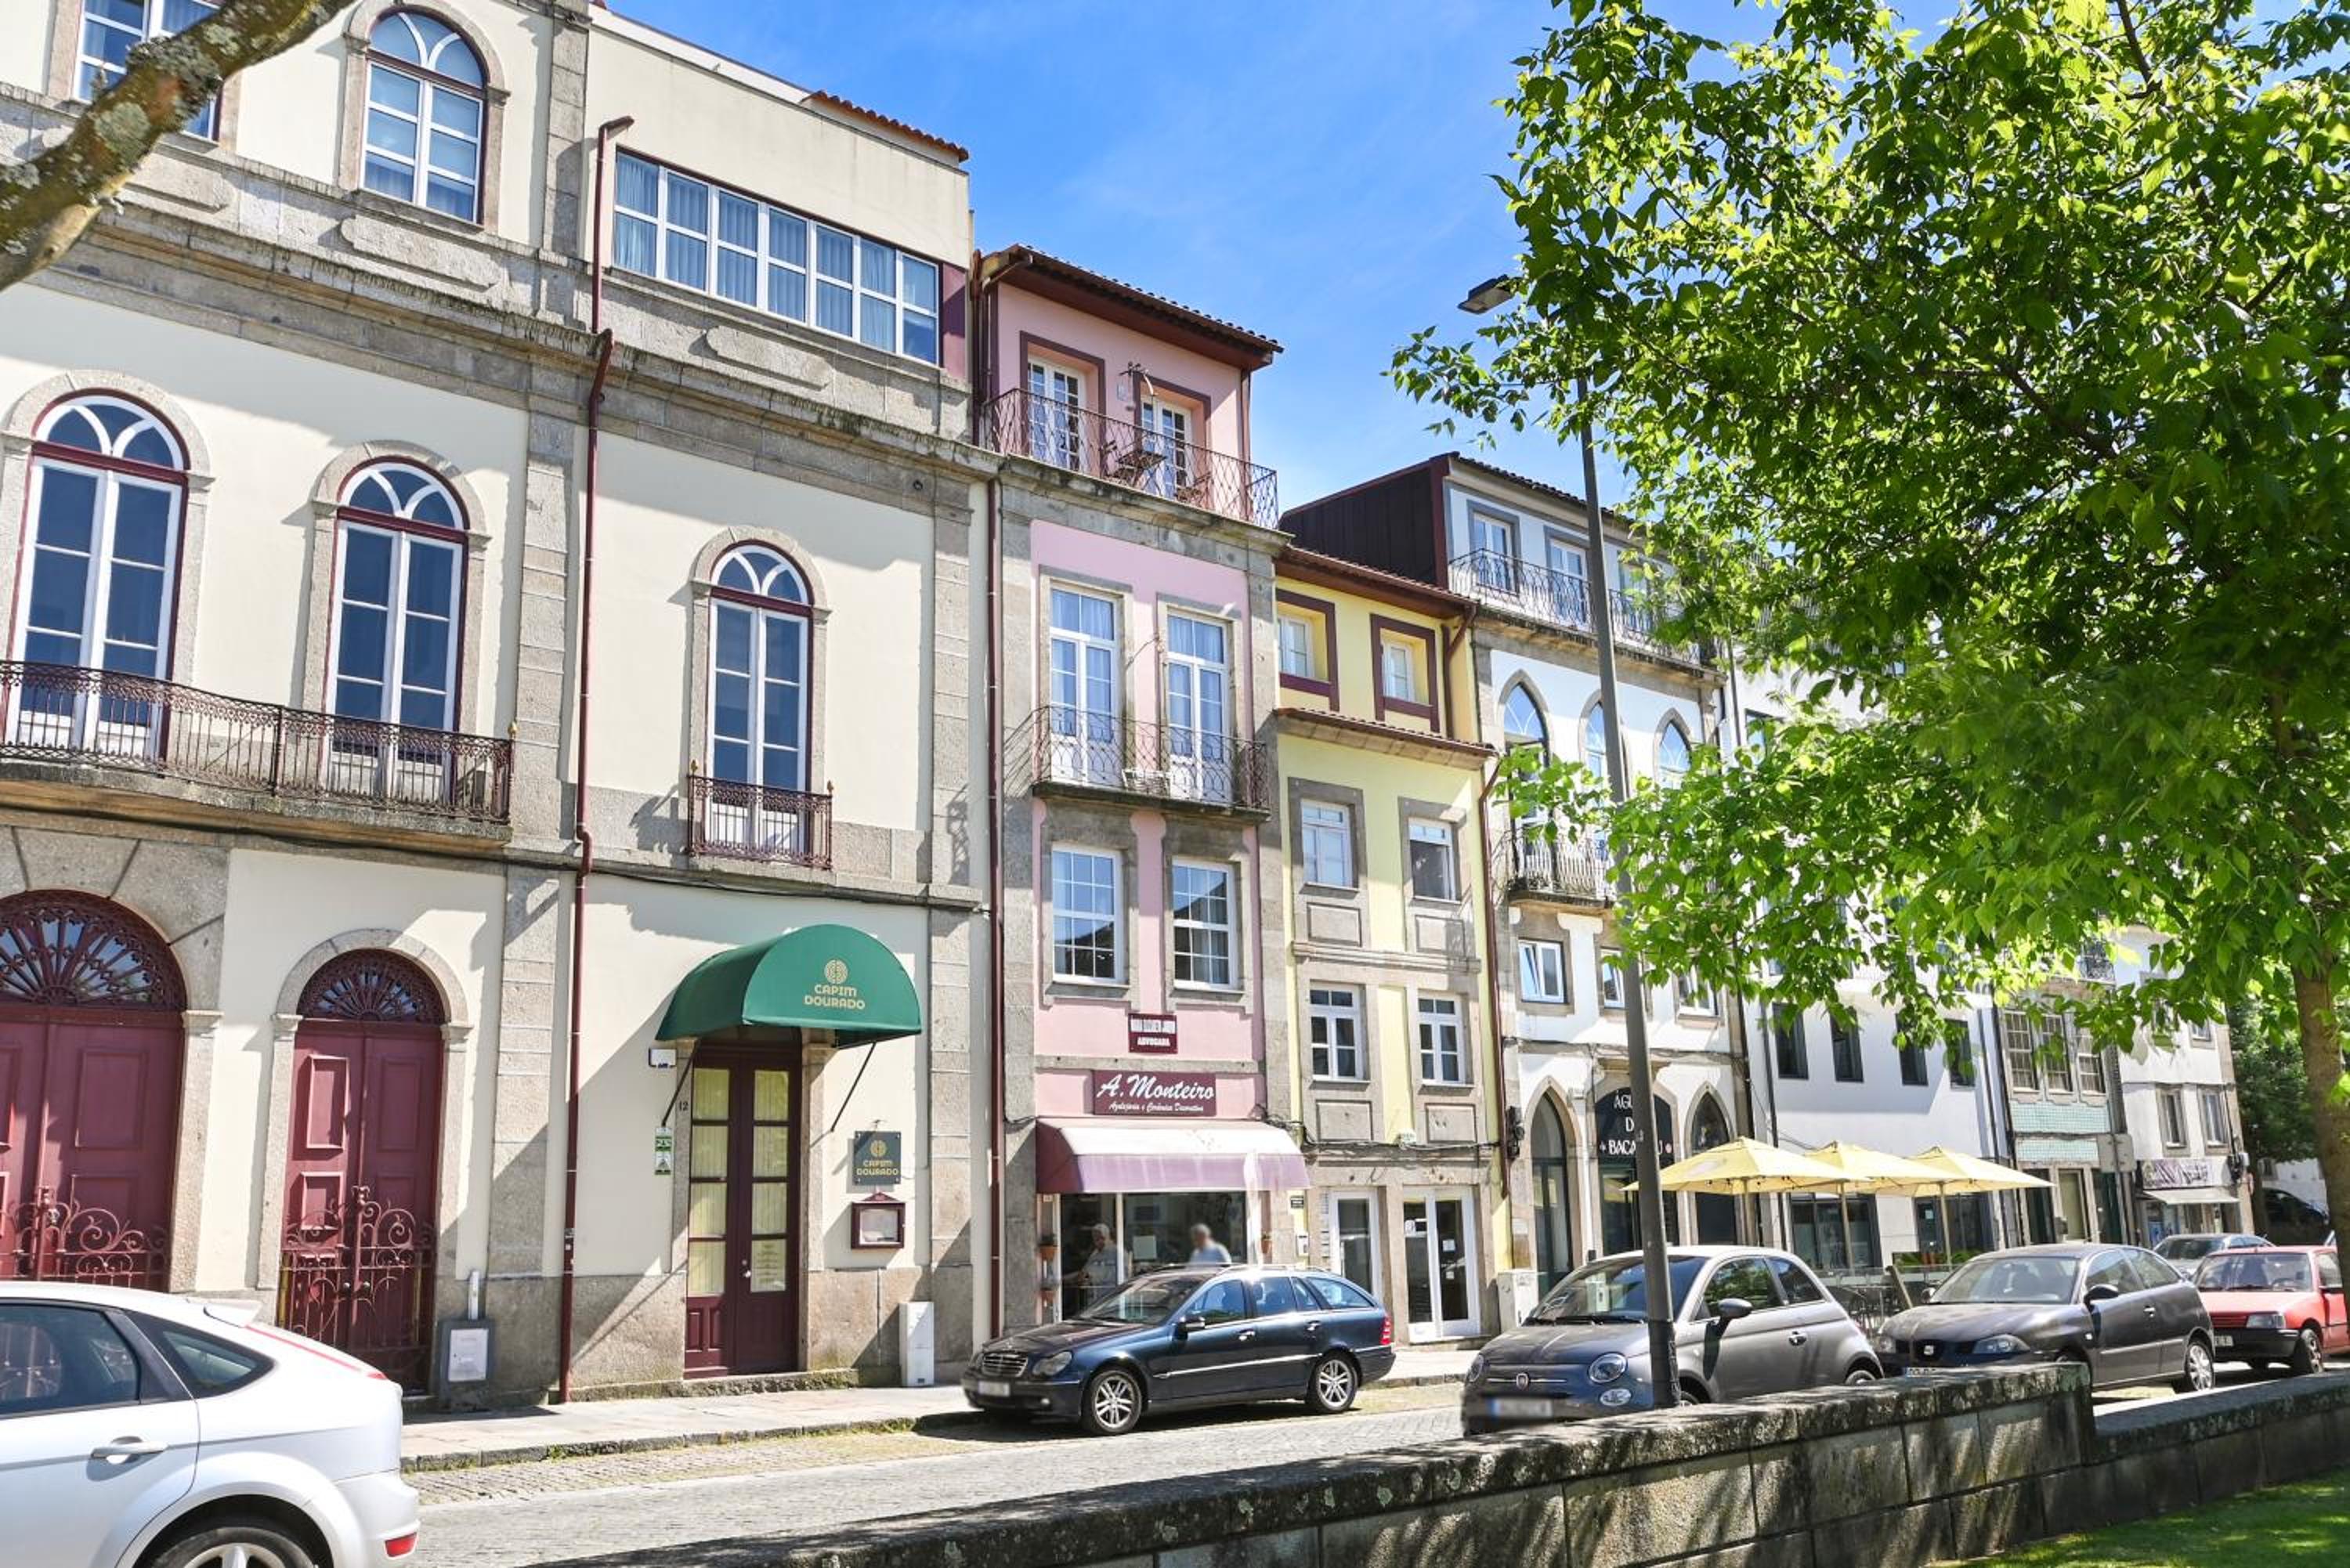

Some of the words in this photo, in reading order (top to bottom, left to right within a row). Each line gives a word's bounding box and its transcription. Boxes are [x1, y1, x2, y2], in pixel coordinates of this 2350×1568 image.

[814, 984, 858, 997] CAPIM
[804, 995, 866, 1010] DOURADO
[1126, 1074, 1214, 1100] Monteiro
